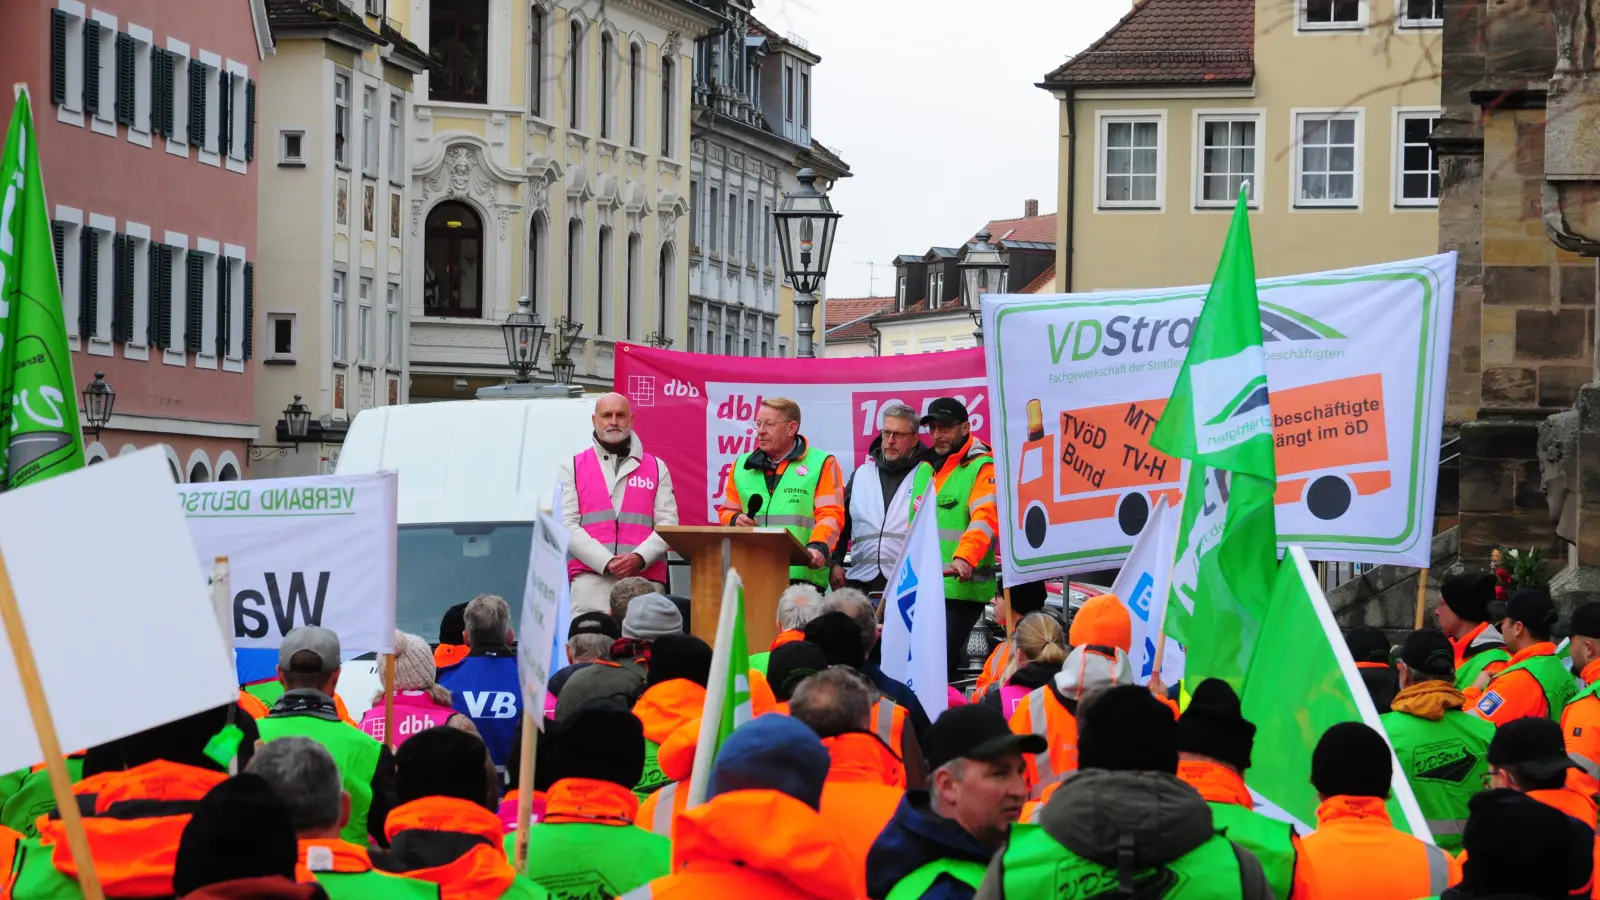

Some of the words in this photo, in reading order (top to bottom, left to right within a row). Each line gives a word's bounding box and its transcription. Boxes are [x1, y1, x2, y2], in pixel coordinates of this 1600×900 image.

[1049, 363, 1126, 384] Fachgewerkschaft
[1129, 362, 1144, 373] der
[663, 379, 700, 398] dbb
[1123, 403, 1159, 436] MT
[1273, 398, 1380, 428] beschäftigte
[1063, 412, 1107, 450] TVöD
[1318, 426, 1338, 441] im
[1344, 419, 1369, 436] öD
[1062, 442, 1106, 489] Bund
[1122, 443, 1167, 481] TV-H
[628, 475, 655, 490] dbb
